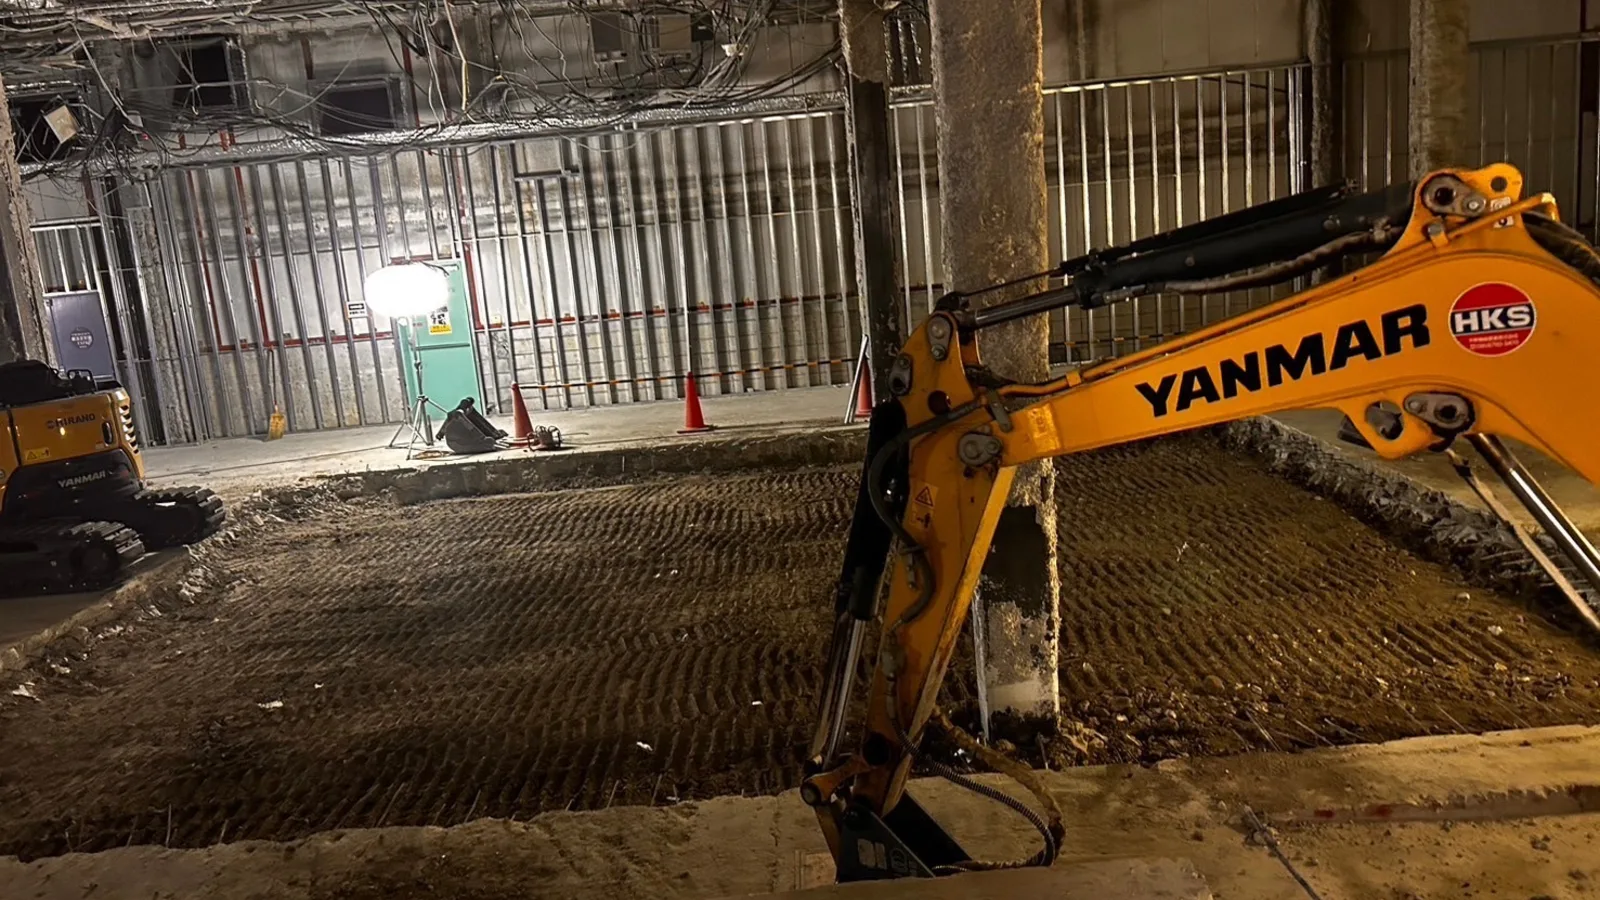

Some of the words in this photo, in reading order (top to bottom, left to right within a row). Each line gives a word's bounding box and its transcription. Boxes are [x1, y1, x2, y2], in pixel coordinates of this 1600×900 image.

[1454, 305, 1531, 333] HKS
[1134, 303, 1431, 418] YANMAR
[58, 470, 106, 488] YANMAR
